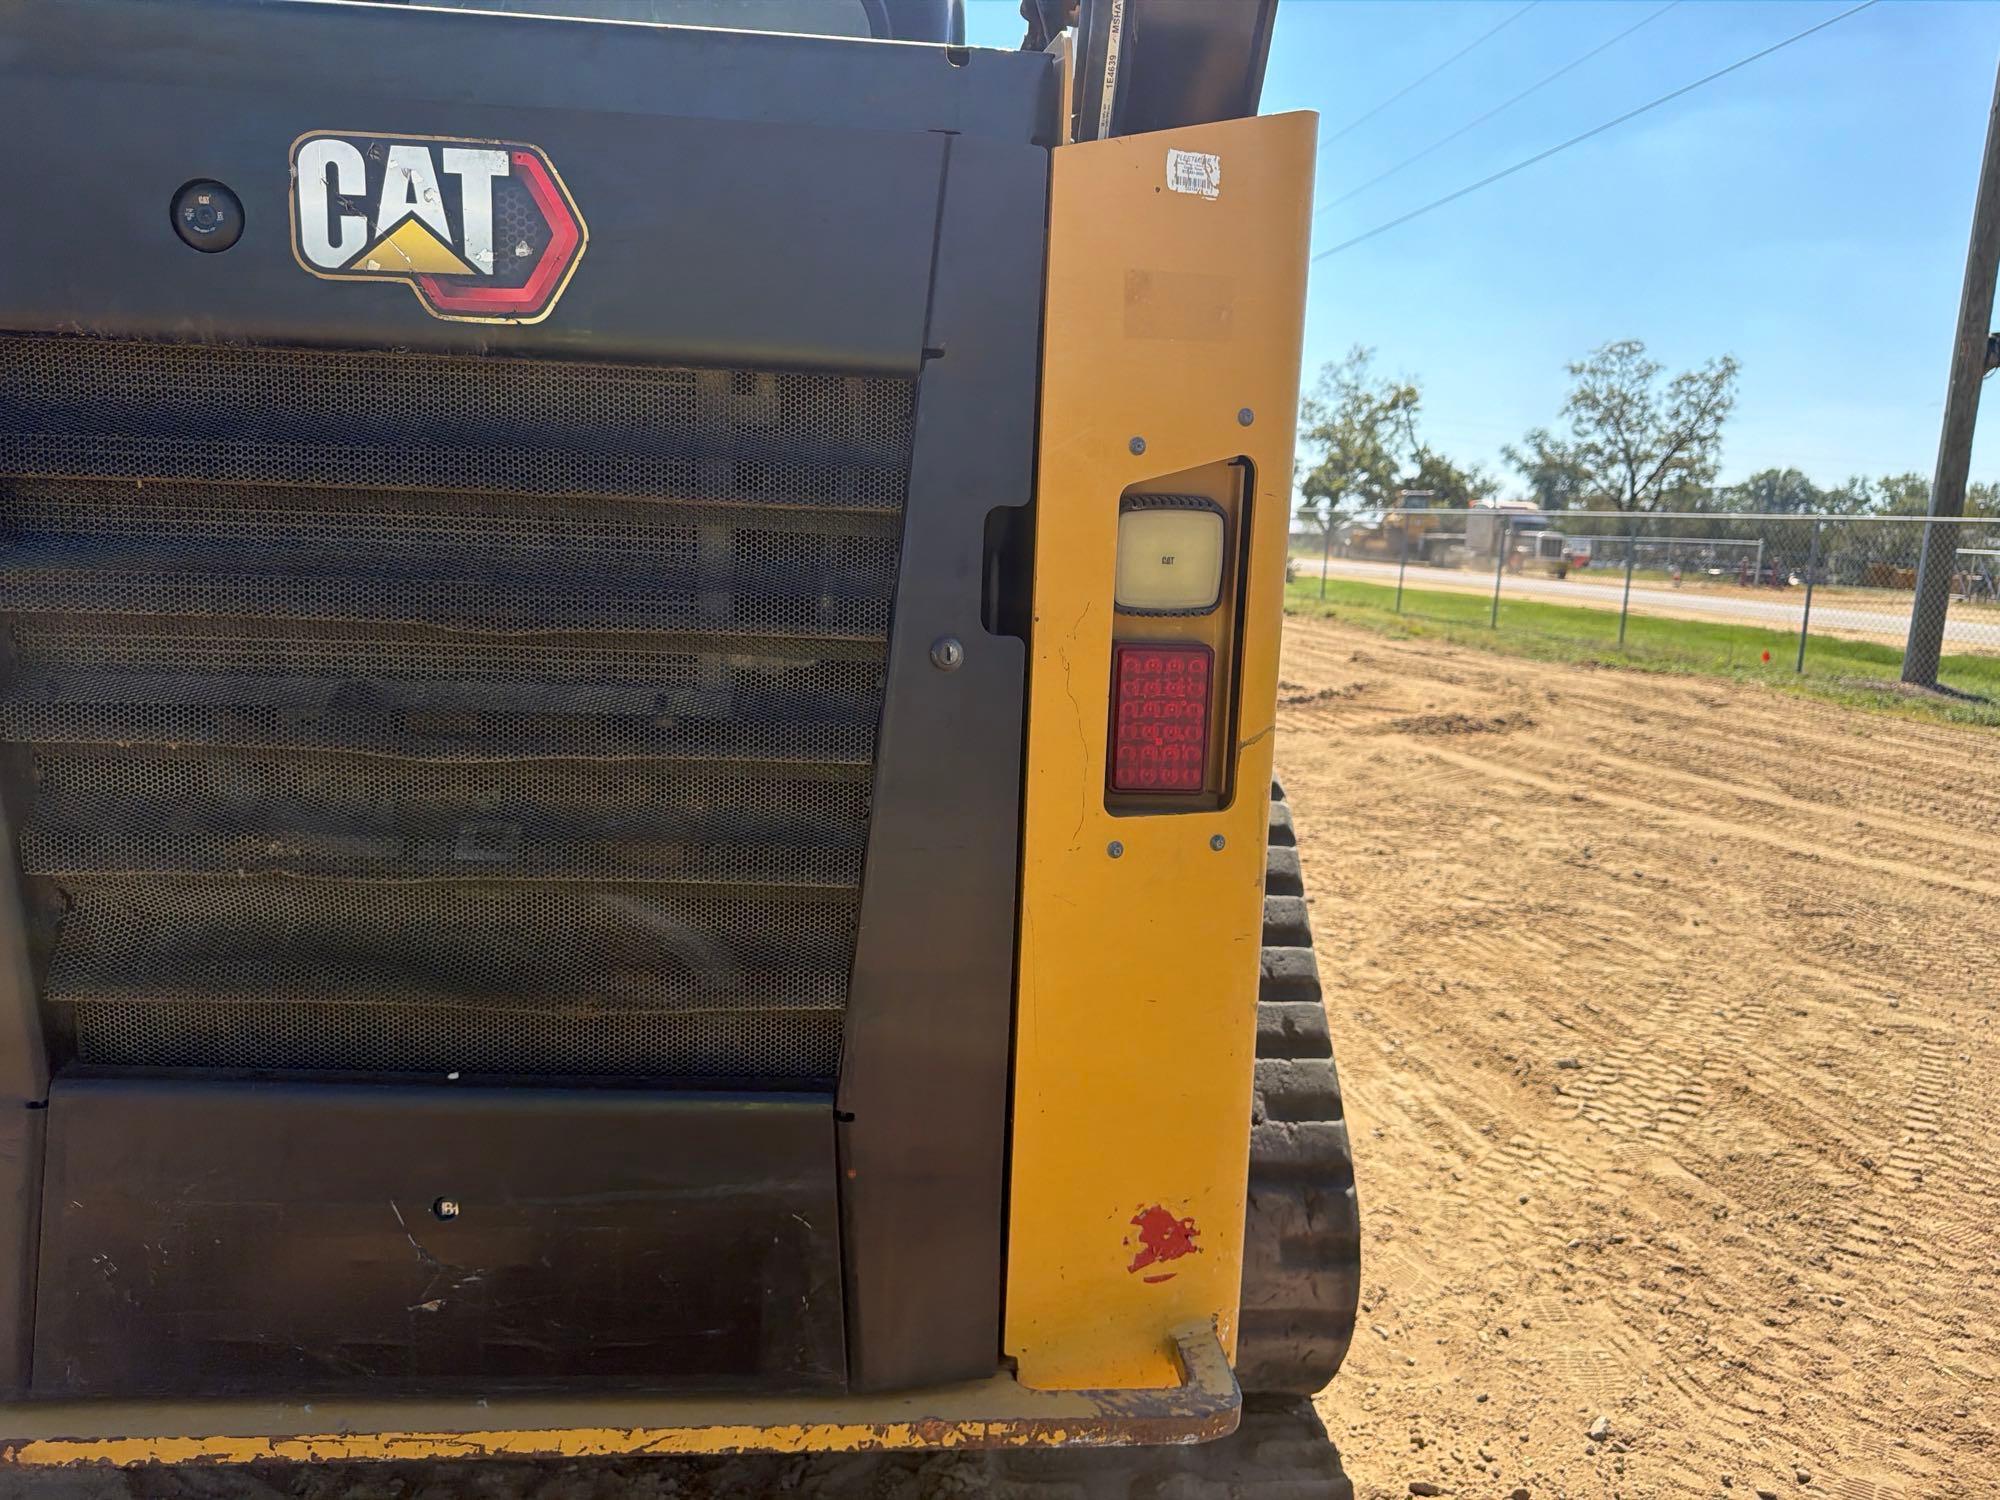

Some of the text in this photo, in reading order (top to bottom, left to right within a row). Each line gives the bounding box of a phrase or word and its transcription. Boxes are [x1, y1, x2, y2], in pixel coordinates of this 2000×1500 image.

[1106, 54, 1117, 89] 1E4639
[298, 138, 510, 276] CAT
[1162, 556, 1175, 565] CAT
